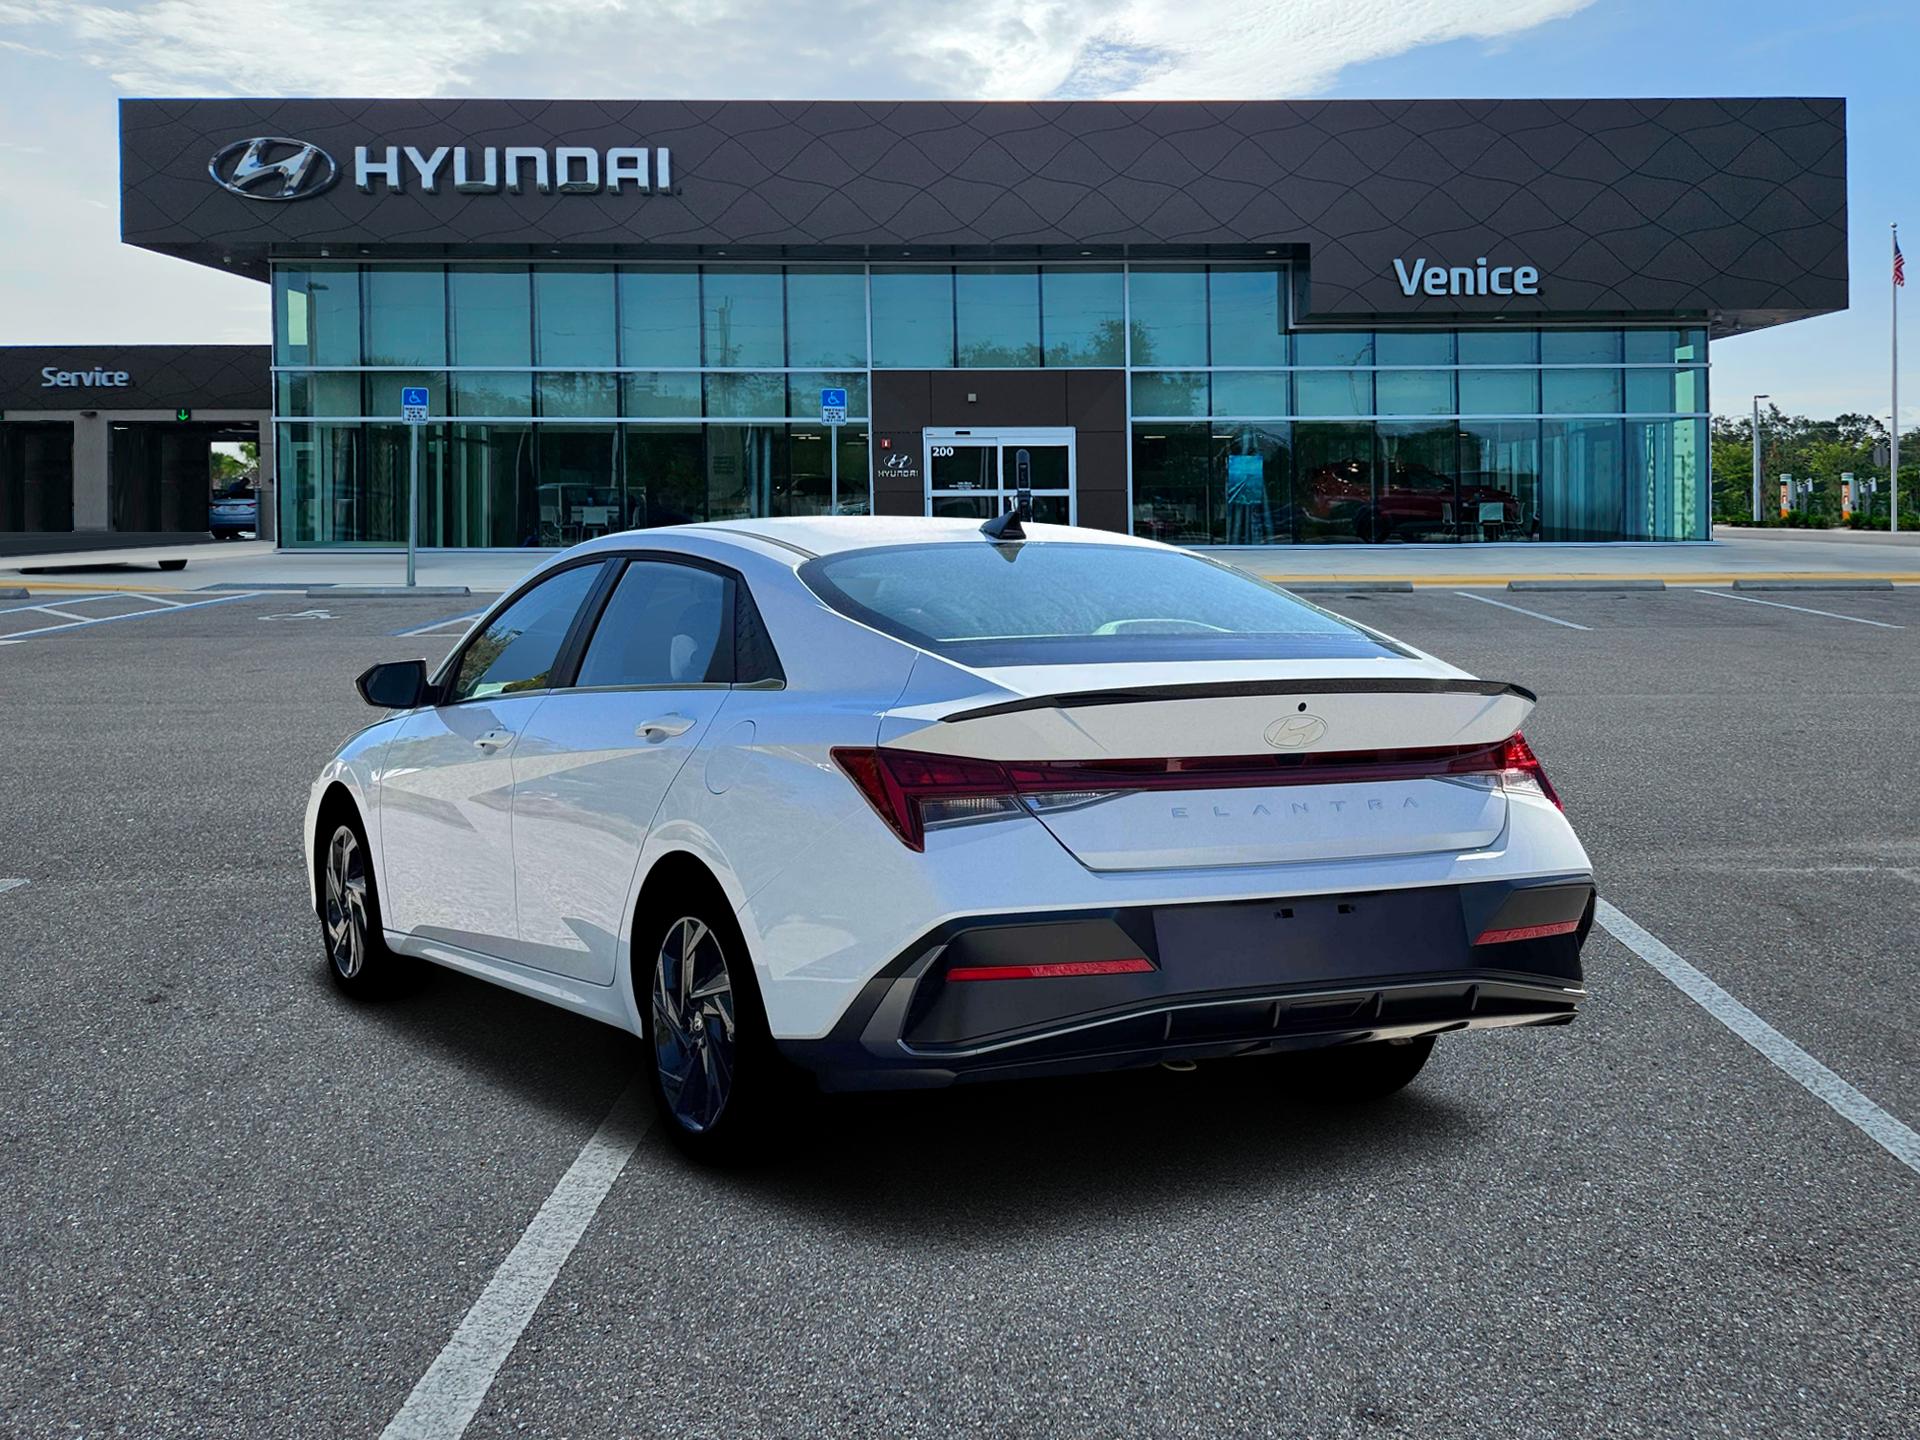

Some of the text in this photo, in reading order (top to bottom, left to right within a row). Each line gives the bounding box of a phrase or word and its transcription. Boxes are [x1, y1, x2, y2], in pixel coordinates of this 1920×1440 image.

[354, 146, 671, 194] HYUNDAI
[1393, 257, 1538, 295] Venice
[41, 367, 130, 387] Service
[932, 447, 954, 457] 200
[1171, 797, 1419, 818] ELANTRA
